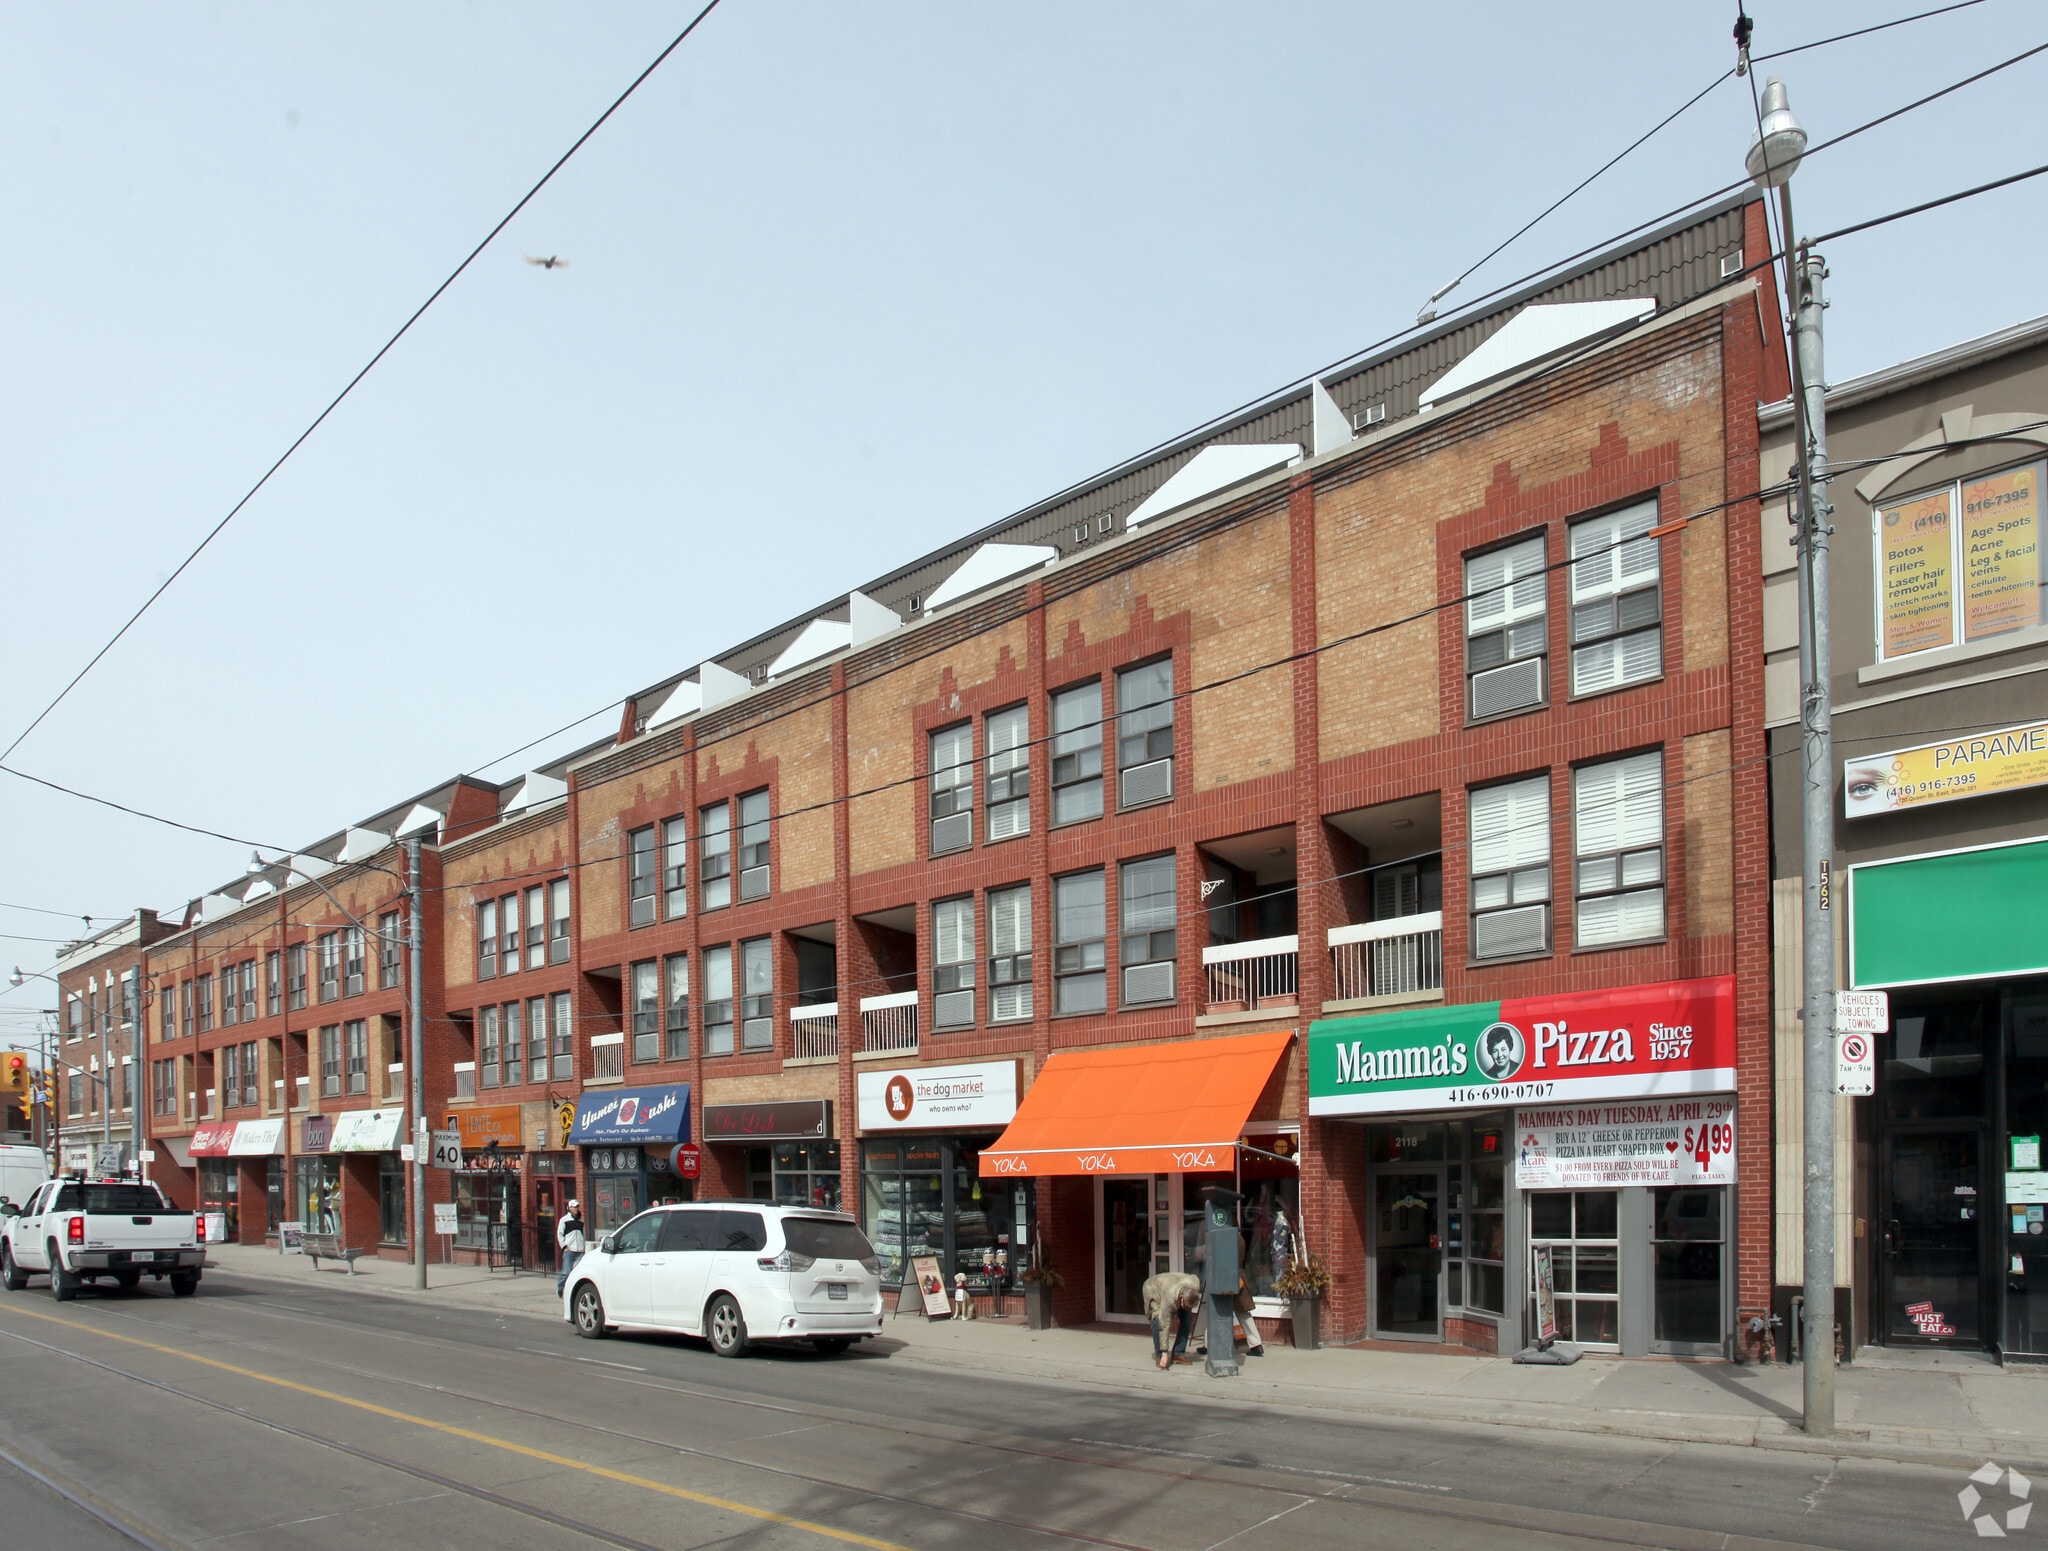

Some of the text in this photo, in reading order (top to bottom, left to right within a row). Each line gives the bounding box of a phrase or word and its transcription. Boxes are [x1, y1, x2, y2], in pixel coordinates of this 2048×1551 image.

[1967, 488, 2029, 514] 916-7395
[1985, 502, 2031, 518] CONSULTATION
[1914, 511, 1947, 531] (416)
[1971, 517, 2031, 539] Age Spots
[1888, 545, 1924, 560] Botox
[1970, 539, 2004, 554] Acne
[1970, 543, 2036, 567] Leg & facial
[1888, 559, 1925, 575] Fillers
[1970, 564, 2000, 577] veins
[1889, 568, 1945, 589] Laser hair
[1971, 575, 2007, 589] cellulite
[1889, 579, 1937, 599] removal
[1971, 579, 2035, 600] teeth whitening
[1889, 590, 1949, 609] stretch marks
[1971, 597, 2019, 614] Welcome!!
[1889, 601, 1950, 621] skin tightening
[1889, 625, 1907, 634] Men
[1917, 616, 1948, 627] Women
[1886, 773, 1976, 799] (416) 916-7395
[1820, 860, 1829, 909] T562
[1841, 995, 1880, 1006] VEHICLES
[1838, 1007, 1885, 1017] SUBJECT TO
[1649, 1023, 1693, 1042] Since
[1847, 1018, 1876, 1029] TOWING
[1336, 1034, 1467, 1084] Mamma's
[1532, 1020, 1635, 1068] Pizza
[1649, 1040, 1693, 1061] 1957
[917, 1080, 983, 1097] the dog market
[581, 1091, 677, 1131] Yumei Sushi
[957, 1103, 972, 1111] who?
[1518, 1101, 1733, 1129] MAMMA'S DAY TUESDAY, APRIL 29th
[308, 1120, 324, 1145] boa
[434, 1134, 460, 1142] MAXIMUM
[1555, 1132, 1569, 1144] BUY
[1570, 1132, 1577, 1144] A
[1592, 1129, 1620, 1143] CHEESE
[1623, 1128, 1634, 1141] OR
[1635, 1126, 1679, 1140] PEPPERONI
[1395, 1137, 1418, 1147] 2118
[1555, 1142, 1664, 1158] PIZZA IN A HEART SHAPED BOX
[436, 1145, 459, 1163] 40
[1077, 1153, 1116, 1171] YOKA
[1172, 1149, 1216, 1168] YOKA
[1527, 1157, 1548, 1166] care
[1534, 1150, 1548, 1158] we
[992, 1156, 1028, 1173] YOKA
[1555, 1160, 1679, 1172] $1.00 FROM EVERY PIZZA SOLD WILL BE
[1562, 1172, 1591, 1182] DONATED
[1593, 1173, 1601, 1181] TO
[1602, 1172, 1630, 1181] FRIENDS
[1631, 1172, 1639, 1181] OF
[1640, 1171, 1651, 1180] WE
[1913, 1313, 1942, 1323] JUST
